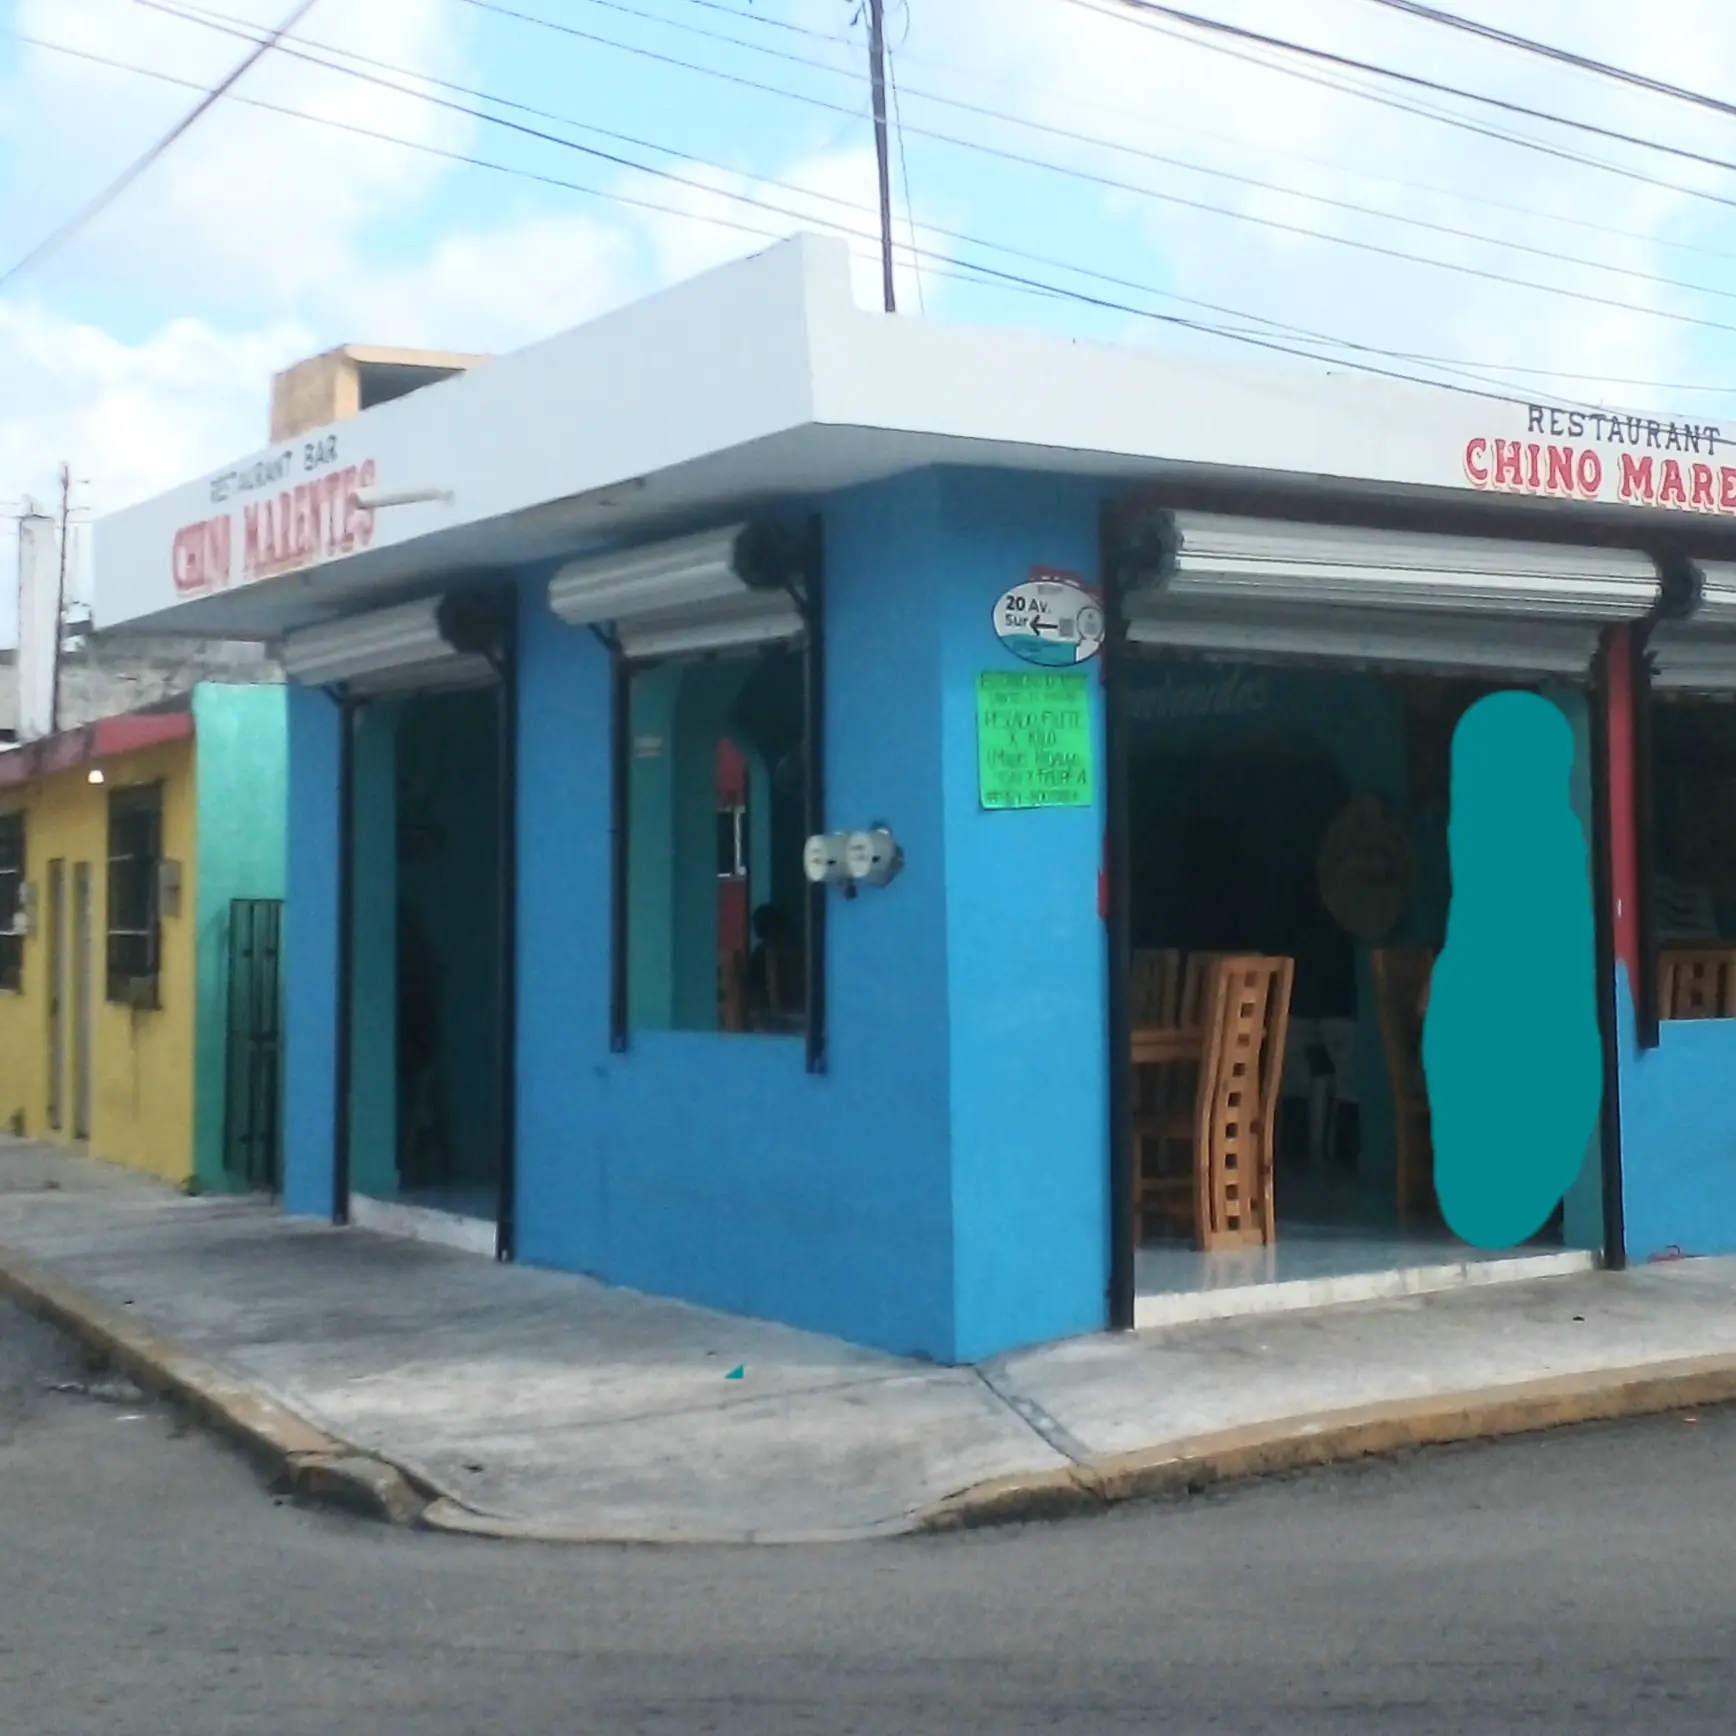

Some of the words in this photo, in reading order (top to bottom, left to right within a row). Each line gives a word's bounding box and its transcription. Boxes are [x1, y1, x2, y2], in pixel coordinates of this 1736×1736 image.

[1527, 404, 1721, 456] RESTAURANT
[1465, 437, 1601, 496] CHINO
[1619, 453, 1736, 512] MARE
[1006, 595, 1026, 611] 20
[1005, 614, 1029, 627] Sur
